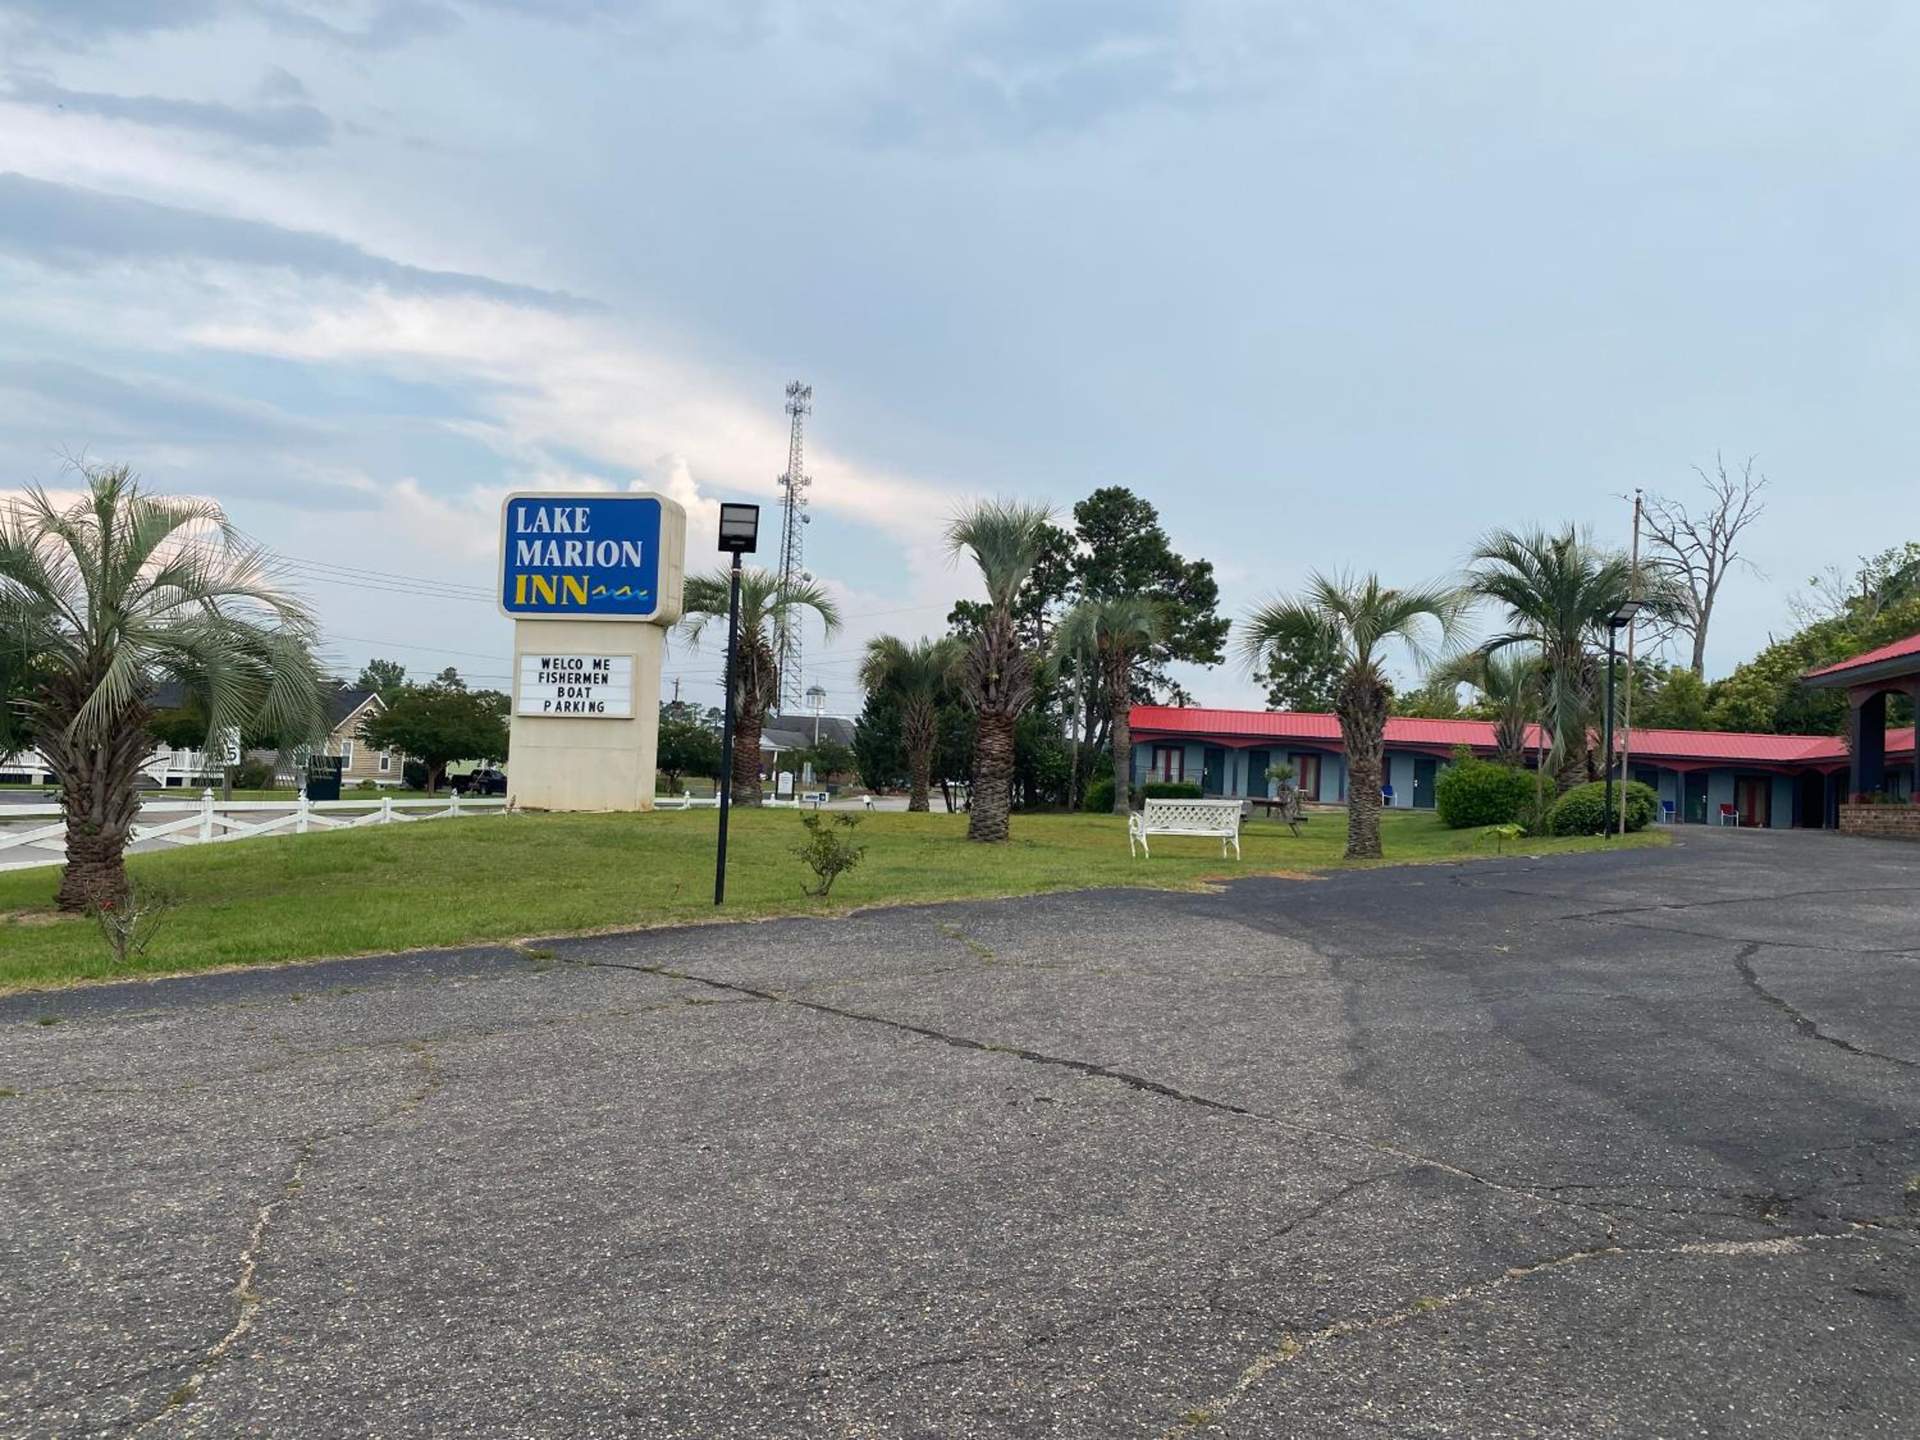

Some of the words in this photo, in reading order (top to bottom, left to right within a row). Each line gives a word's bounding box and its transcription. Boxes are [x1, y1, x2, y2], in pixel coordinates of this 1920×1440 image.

[516, 506, 590, 533] LAKE
[515, 540, 643, 568] MARION
[514, 574, 590, 605] INN
[538, 672, 609, 684] FISHERMEN
[557, 687, 592, 698] BOAT
[544, 701, 605, 712] PARKING
